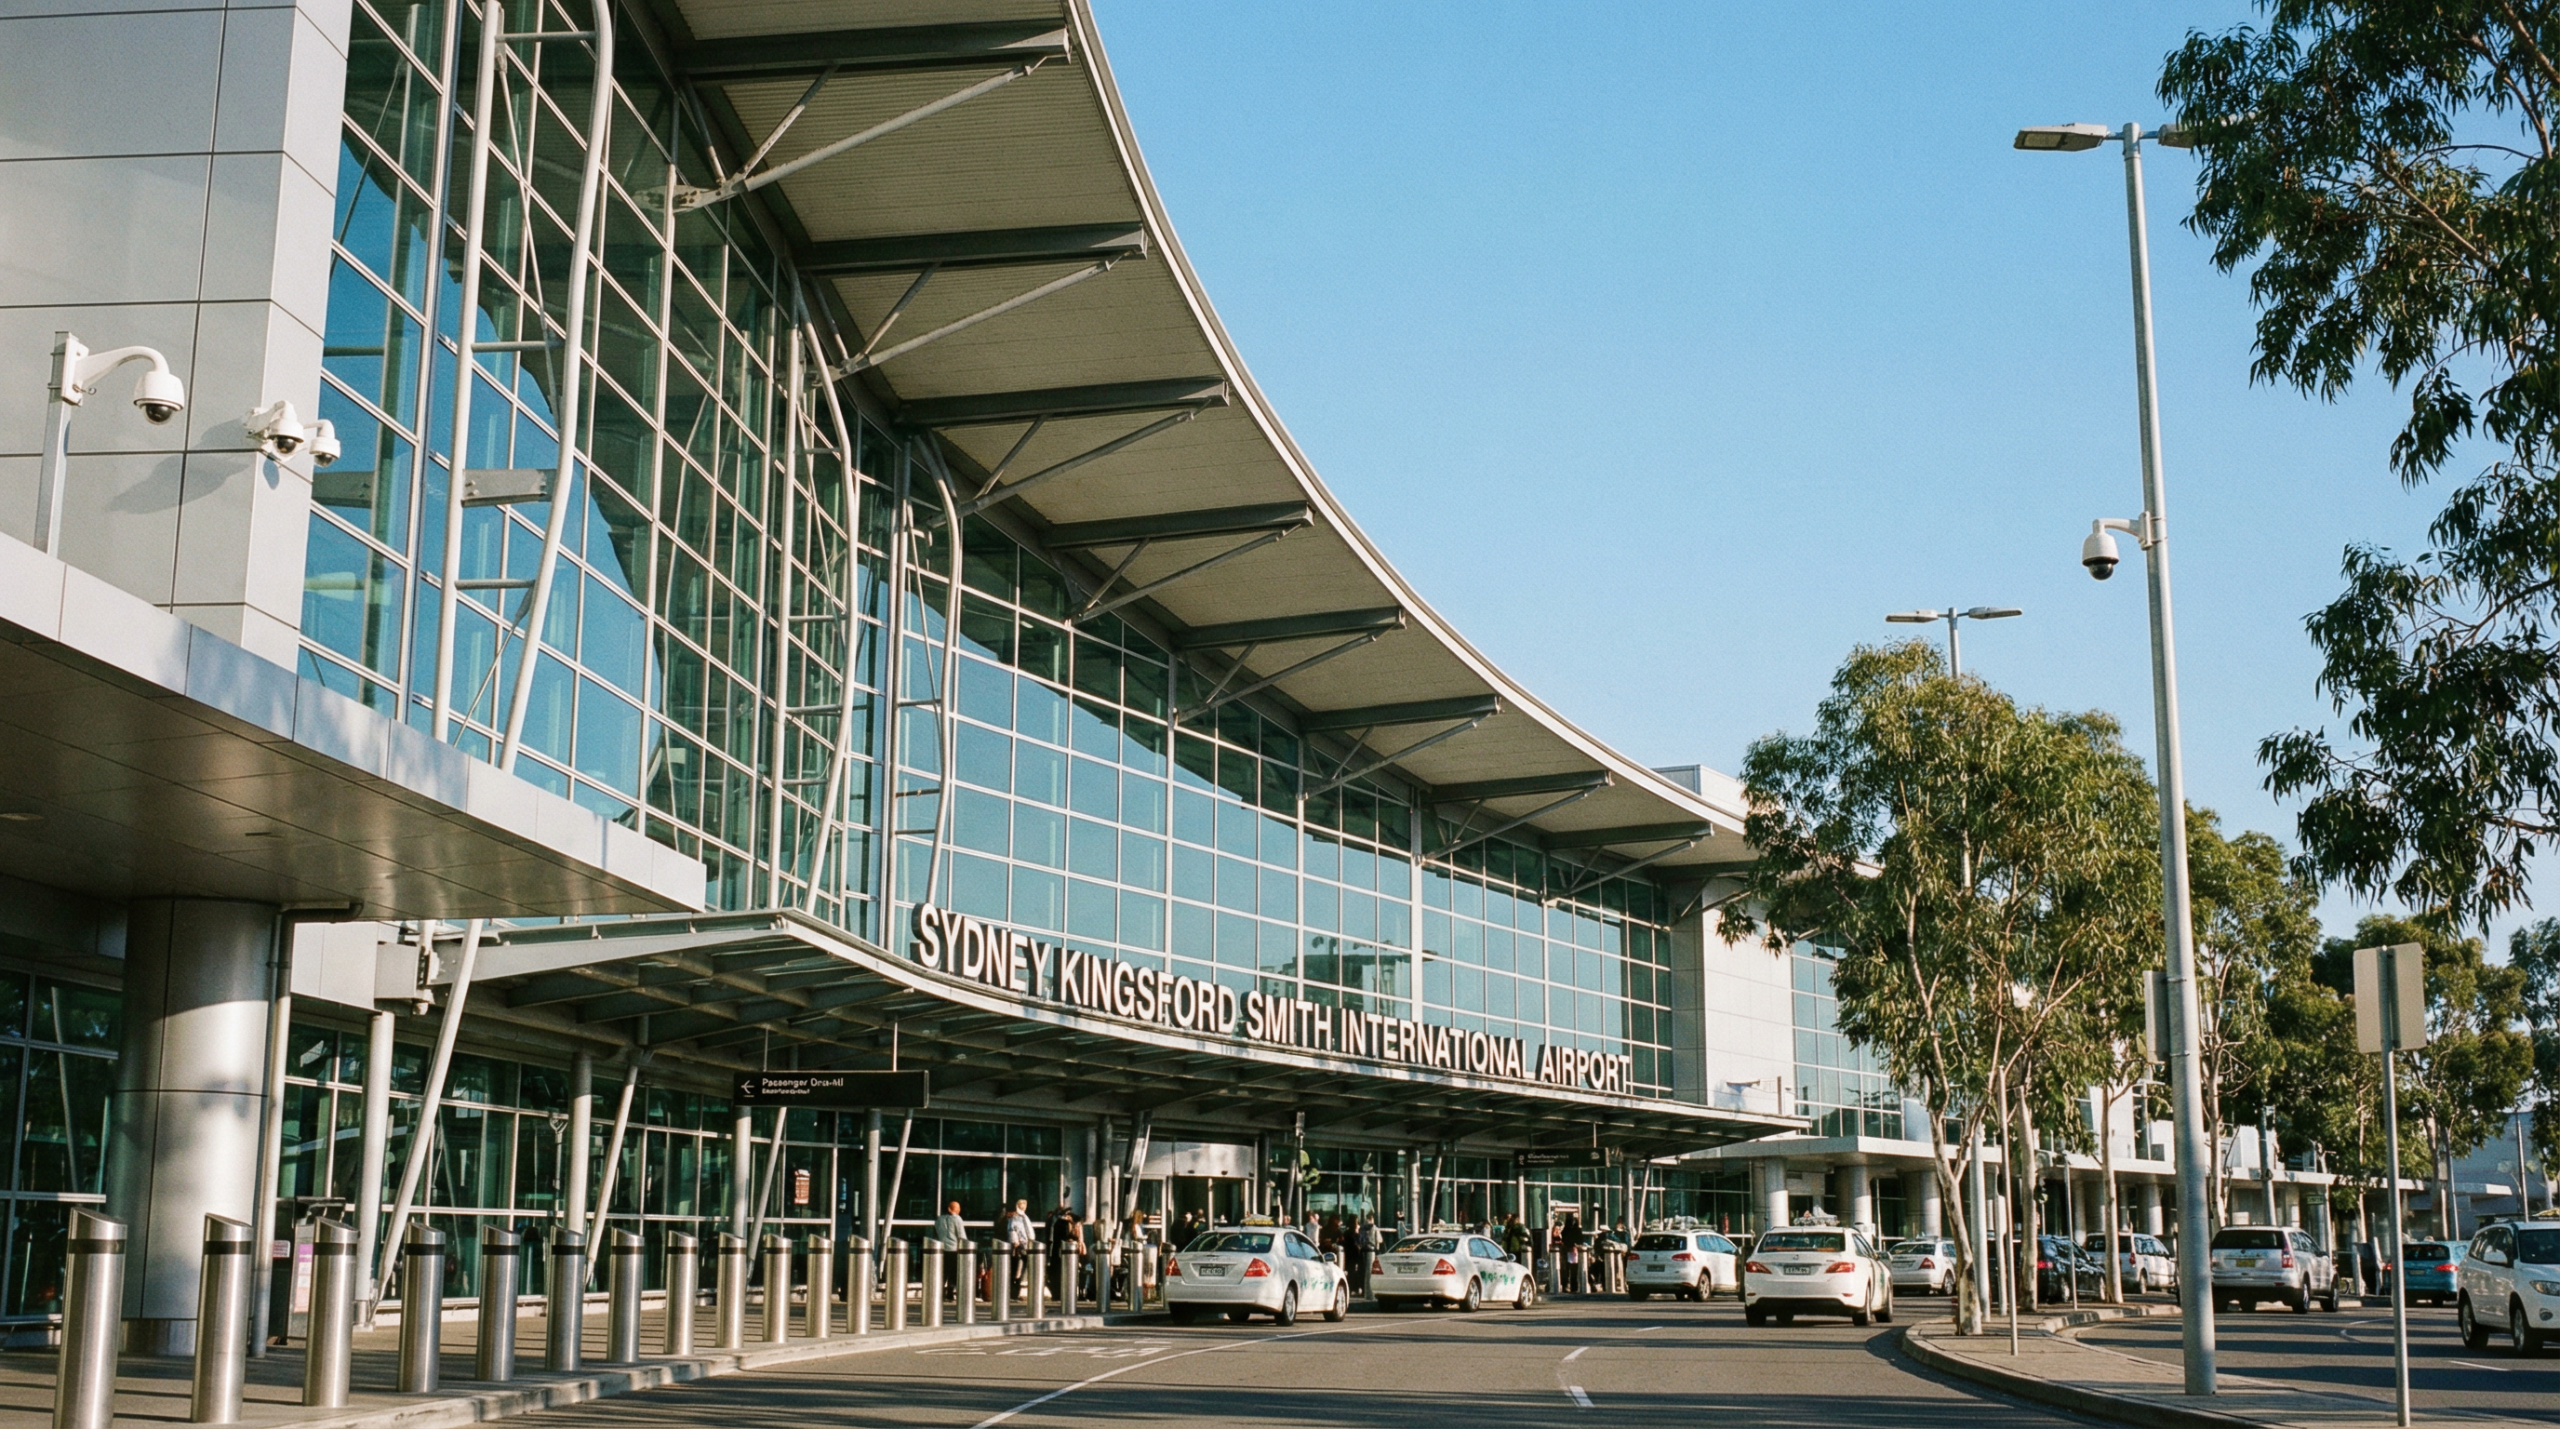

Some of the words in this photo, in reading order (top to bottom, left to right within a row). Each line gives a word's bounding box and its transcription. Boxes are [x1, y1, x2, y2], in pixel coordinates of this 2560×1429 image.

[917, 902, 1051, 997] SYDNEY
[1060, 947, 1237, 1034] KINGSFORD
[1245, 990, 1332, 1051] SMITH
[1340, 1007, 1536, 1080] INTERNATIONAL
[1539, 1044, 1630, 1094] AIRPORT
